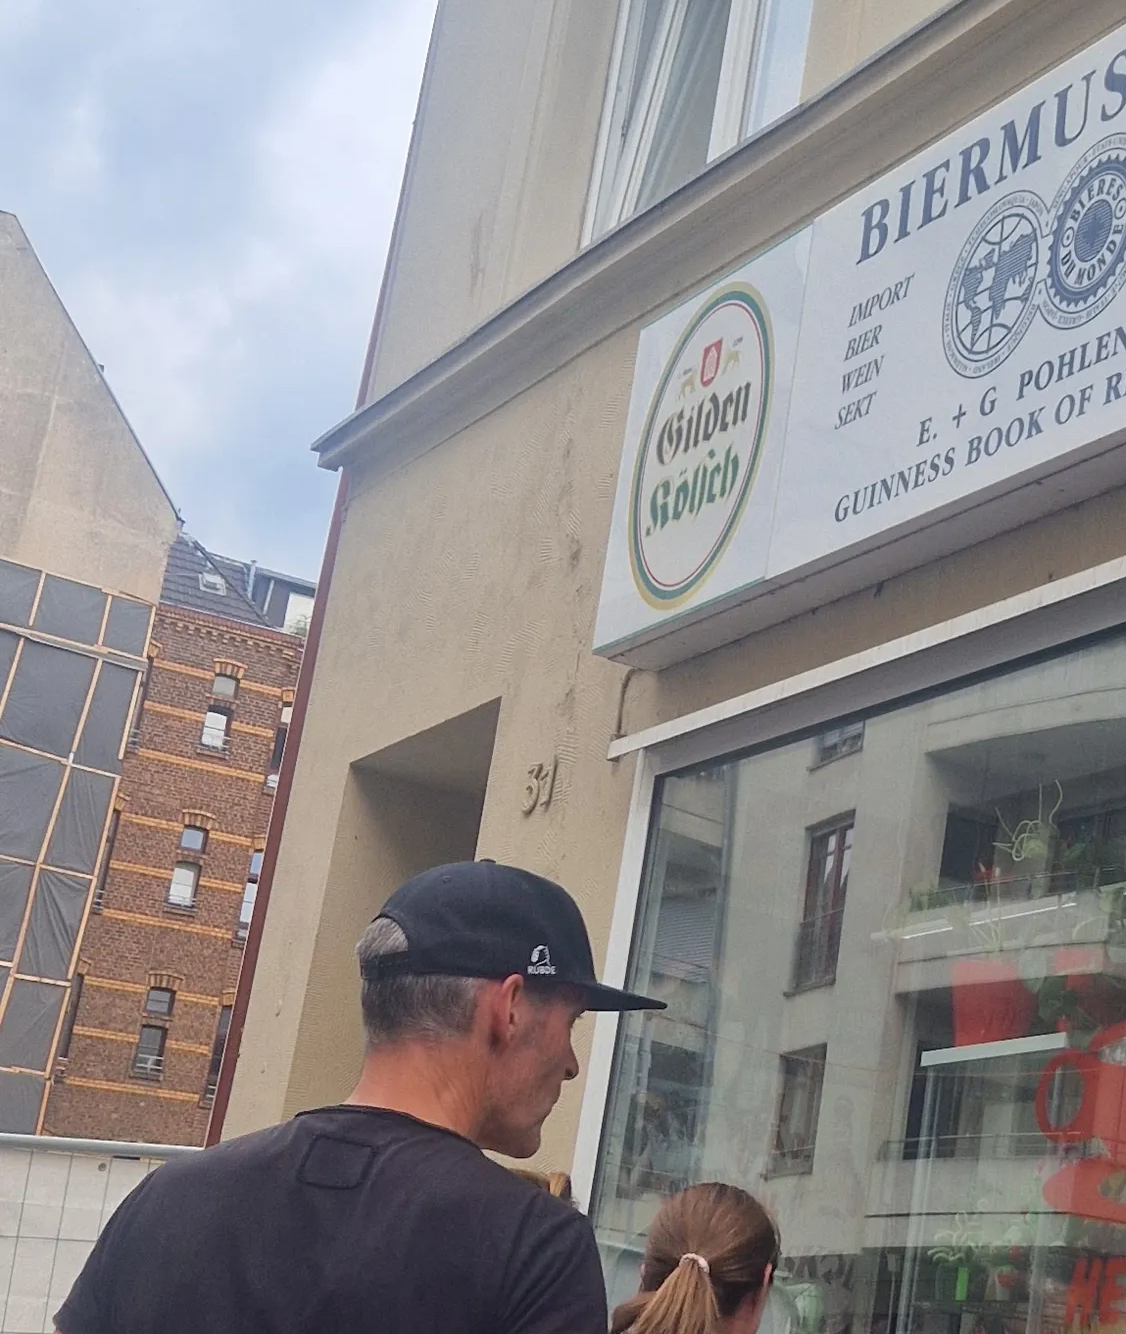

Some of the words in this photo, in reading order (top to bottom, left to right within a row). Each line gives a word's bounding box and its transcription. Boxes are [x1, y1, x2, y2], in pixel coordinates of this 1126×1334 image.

[1070, 176, 1125, 223] BIERES
[1060, 249, 1077, 280] DU
[1074, 224, 1125, 287] MONDE
[848, 272, 915, 328] IMPORT
[843, 324, 883, 363] BIER
[841, 356, 885, 395] WEIN
[656, 381, 752, 467] Gilden
[834, 390, 878, 431] SEKT
[916, 416, 938, 448] E.
[833, 447, 956, 524] GUINNESS
[964, 407, 1046, 468] BOOK
[1054, 383, 1096, 426] OF
[521, 755, 559, 816] 31
